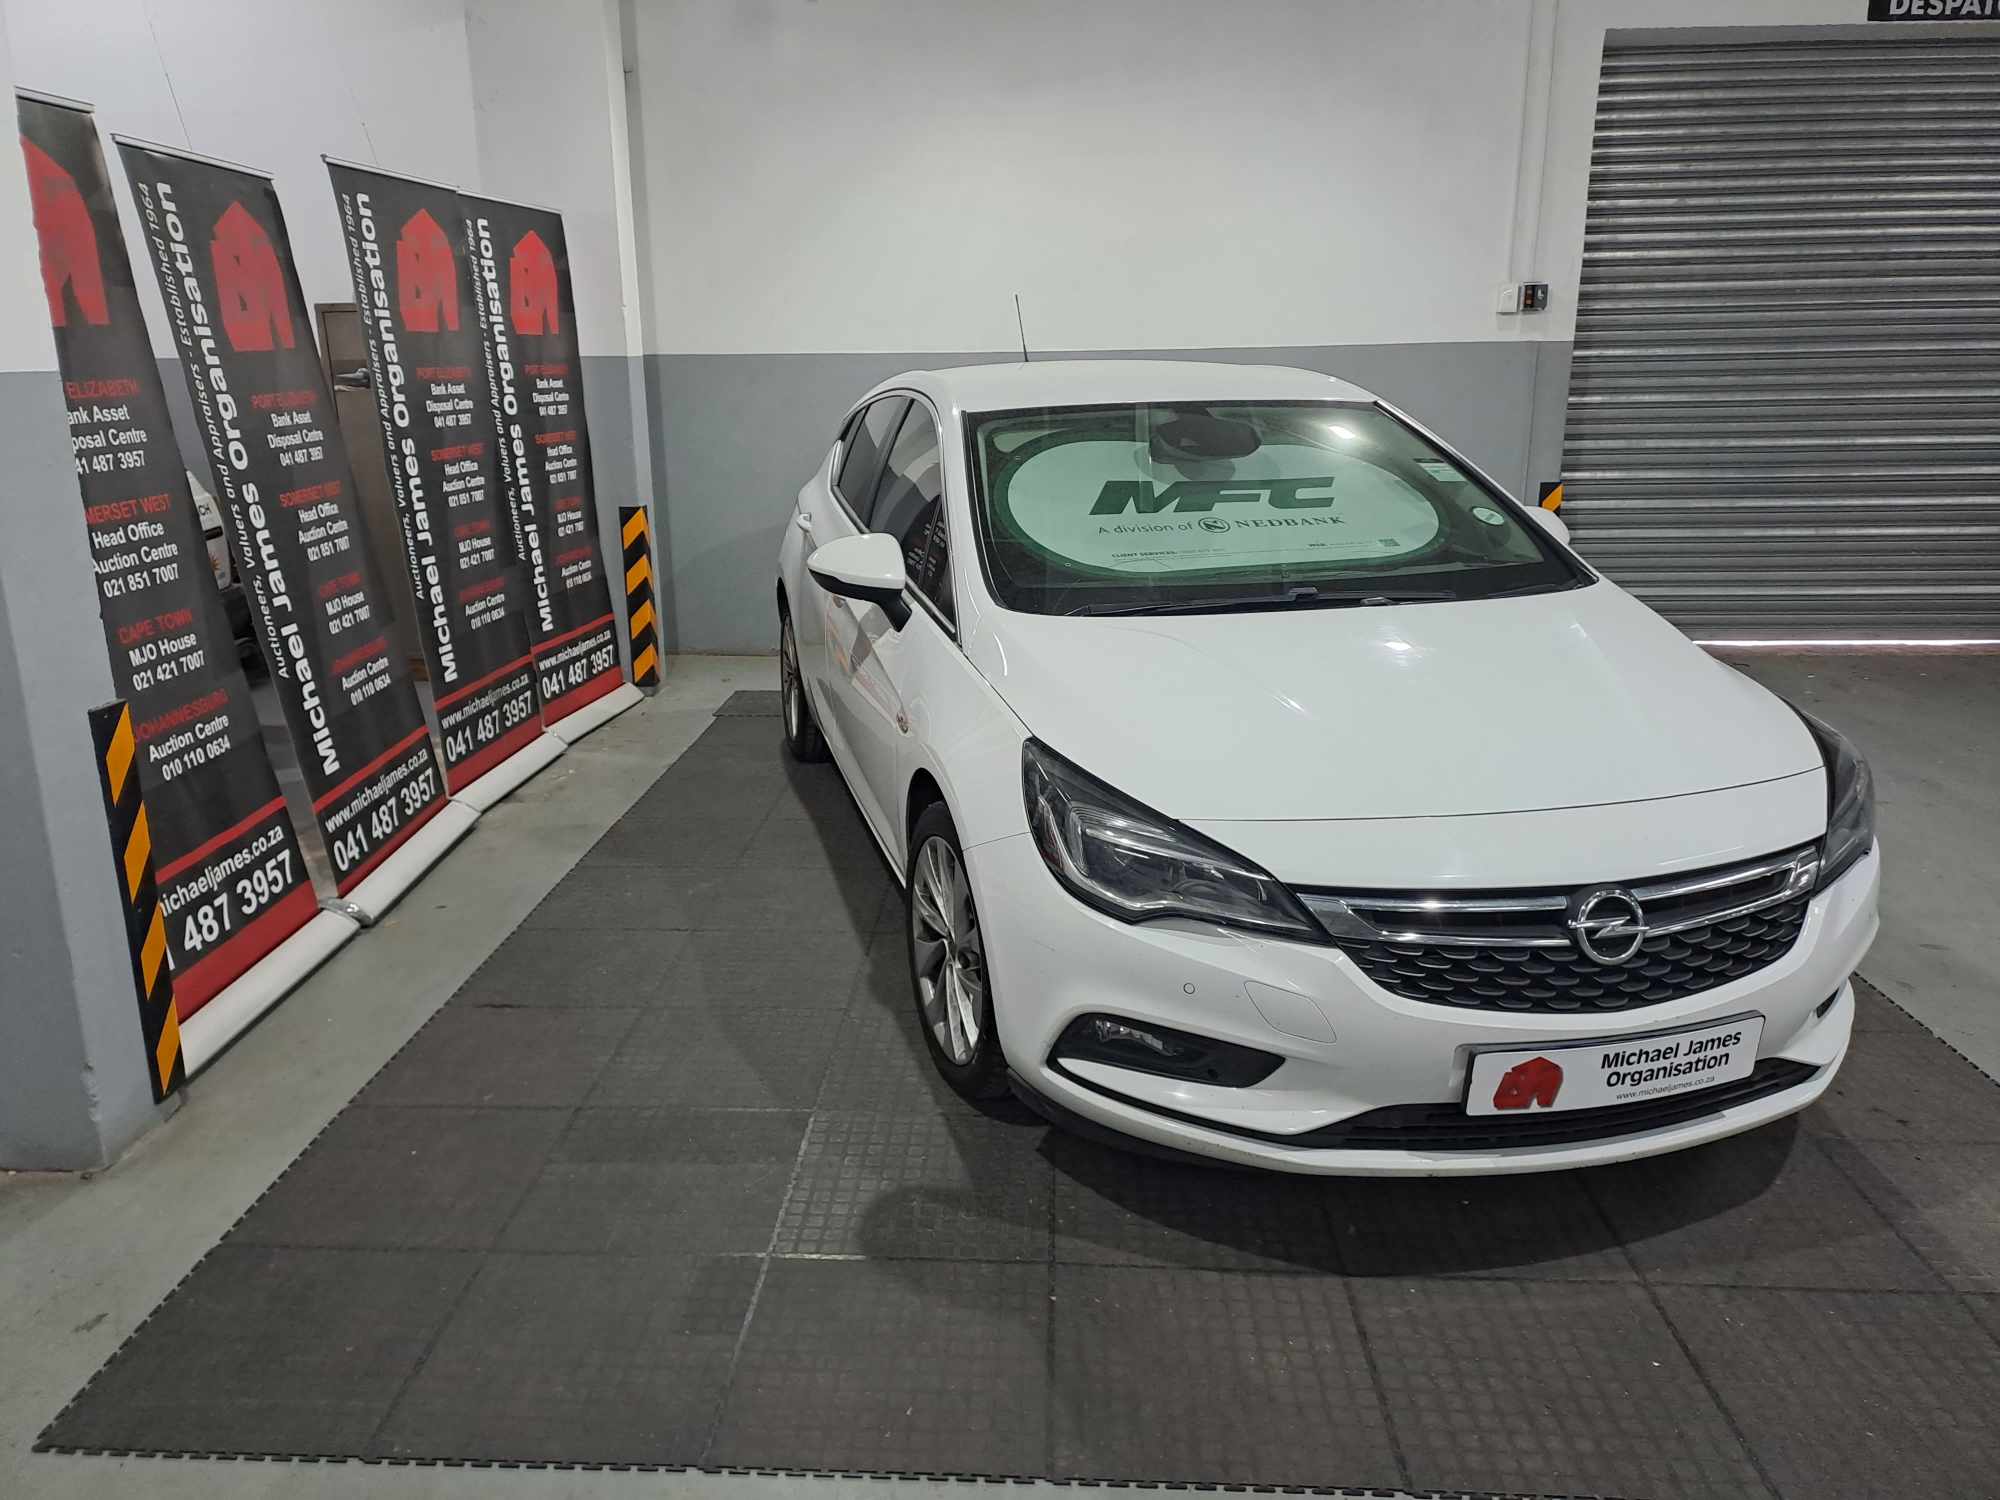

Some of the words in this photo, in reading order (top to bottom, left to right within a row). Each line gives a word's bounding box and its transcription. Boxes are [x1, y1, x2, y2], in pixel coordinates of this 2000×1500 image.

[1889, 0, 2000, 16] DESPAT
[137, 182, 159, 230] 1964
[341, 193, 356, 232] 1964
[151, 235, 192, 346] Established
[348, 235, 372, 325] Established
[156, 182, 248, 470] Organisation
[356, 192, 410, 428] Organisation
[477, 218, 518, 416] Organisation
[368, 338, 391, 417] Appraisers
[67, 406, 91, 424] ank
[93, 404, 130, 423] Asset
[190, 363, 225, 459] Appraisers
[271, 412, 292, 427] Bank
[72, 429, 106, 454] posal
[108, 428, 147, 445] Centre
[267, 430, 302, 449] Disposal
[382, 420, 396, 450] and
[75, 457, 89, 474] 41
[92, 454, 113, 472] 487
[117, 450, 144, 469] 3957
[280, 451, 294, 466] 041
[294, 449, 308, 463] 487
[509, 423, 535, 516] James
[216, 464, 236, 498] and
[390, 454, 406, 507] Valuers
[401, 438, 433, 546] James
[1089, 476, 1336, 516] MFC
[85, 500, 137, 524] MERSET
[141, 494, 170, 512] WEST
[298, 506, 318, 523] Head
[1099, 526, 1110, 534] A
[1113, 523, 1174, 534] division
[1178, 521, 1194, 531] of
[1234, 516, 1347, 528] NEDBANK
[92, 527, 126, 549] Head
[128, 522, 164, 541] Office
[230, 504, 256, 568] Valuers
[242, 482, 292, 612] James
[298, 526, 327, 544] Auction
[307, 545, 321, 561] 021
[320, 541, 334, 556] 851
[92, 552, 139, 574] Auction
[141, 543, 178, 562] Centre
[523, 523, 554, 632] Michael
[103, 577, 126, 598] 021
[127, 570, 151, 591] 851
[152, 563, 179, 584] 7007
[118, 619, 153, 644] CAPE
[157, 608, 193, 631] TOWN
[329, 619, 342, 634] 021
[421, 555, 459, 683] Michael
[129, 644, 157, 667] MJO
[158, 633, 197, 653] House
[132, 671, 154, 691] 021
[156, 661, 179, 681] 421
[180, 650, 205, 673] 7007
[342, 668, 367, 690] Auction
[363, 682, 375, 698] 110
[542, 669, 566, 699] 041
[568, 658, 587, 685] 487
[591, 644, 613, 674] 3957
[280, 622, 340, 776] Michael
[149, 731, 194, 763] Auction
[195, 715, 229, 739] Centre
[446, 725, 473, 762] 041
[477, 709, 500, 741] 487
[502, 690, 531, 727] 3957
[162, 758, 182, 780] 010
[183, 748, 204, 769] 110
[206, 734, 231, 759] 0634
[325, 749, 428, 833] www.michaeljames.co.za
[334, 824, 368, 871] 041
[371, 796, 399, 840] 487
[401, 768, 436, 815] 3957
[160, 825, 284, 917] ichaeljames.co.za
[184, 892, 231, 951] 487
[236, 849, 292, 914] 3957
[1601, 1042, 1681, 1069] Michael
[1685, 1031, 1742, 1056] James
[1606, 1052, 1730, 1088] Organisation
[1616, 1075, 1716, 1101] www.michaeljames.co.za
